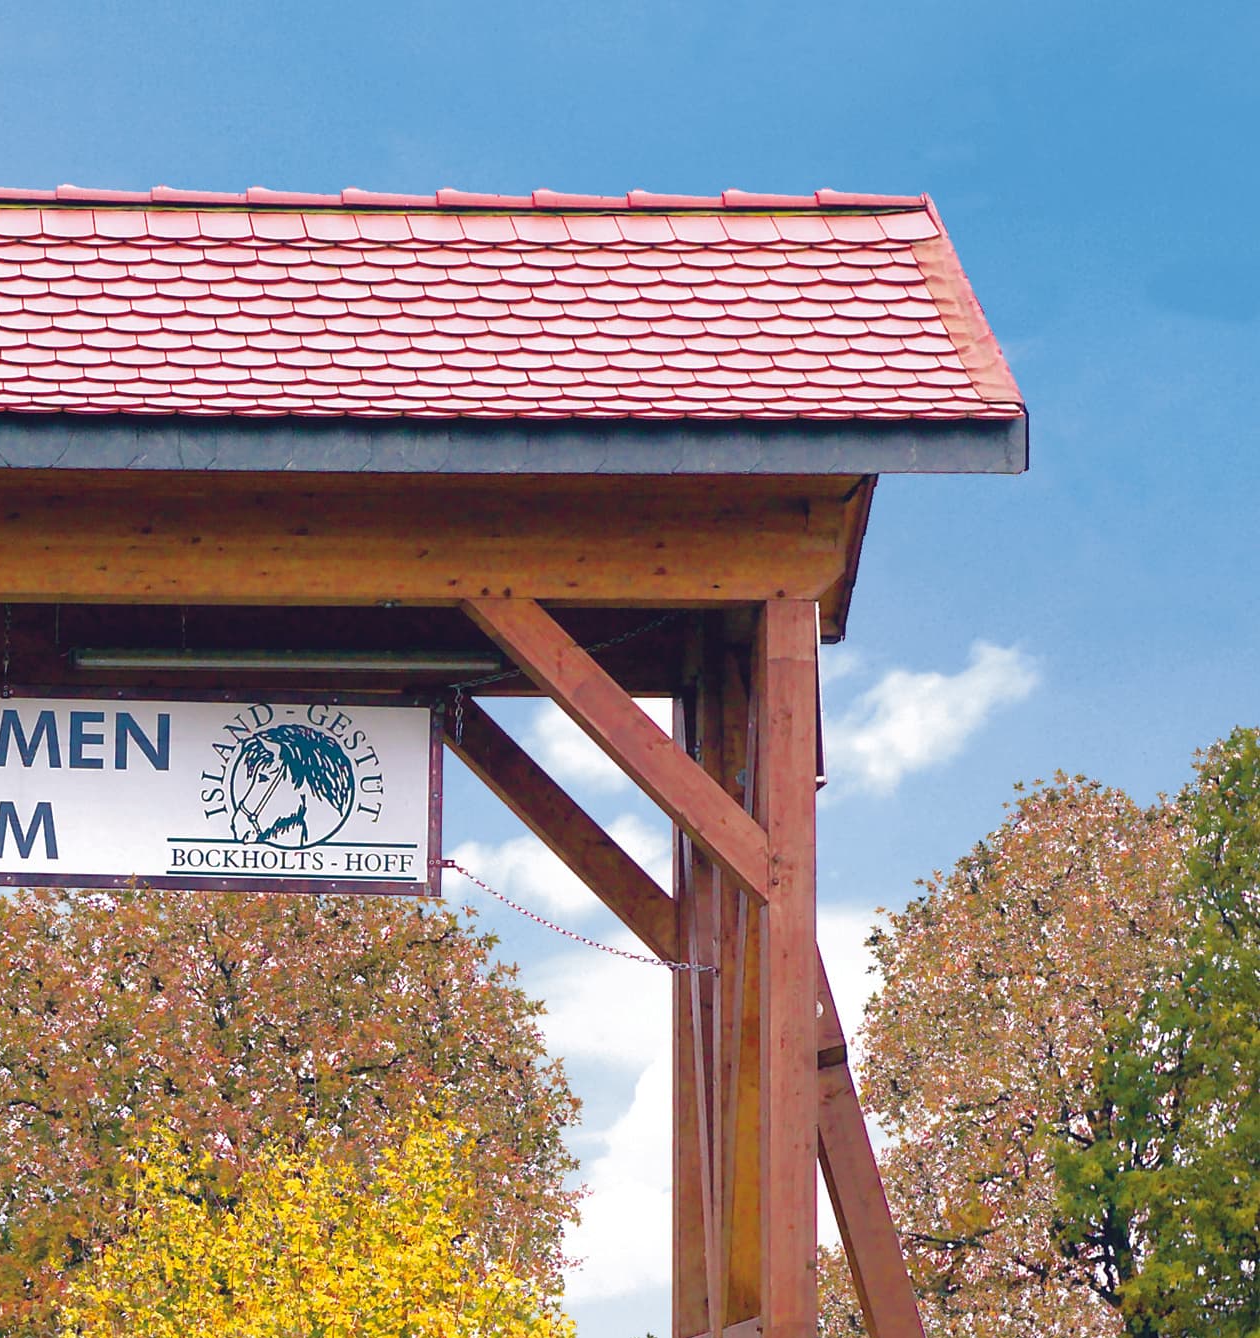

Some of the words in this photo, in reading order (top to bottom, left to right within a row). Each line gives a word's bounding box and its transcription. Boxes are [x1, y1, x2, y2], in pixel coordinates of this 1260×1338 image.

[201, 703, 274, 820] ISLAND
[307, 704, 384, 823] GESTÜT
[170, 848, 324, 871] BOCKHOLTS
[344, 852, 414, 873] HOFF
